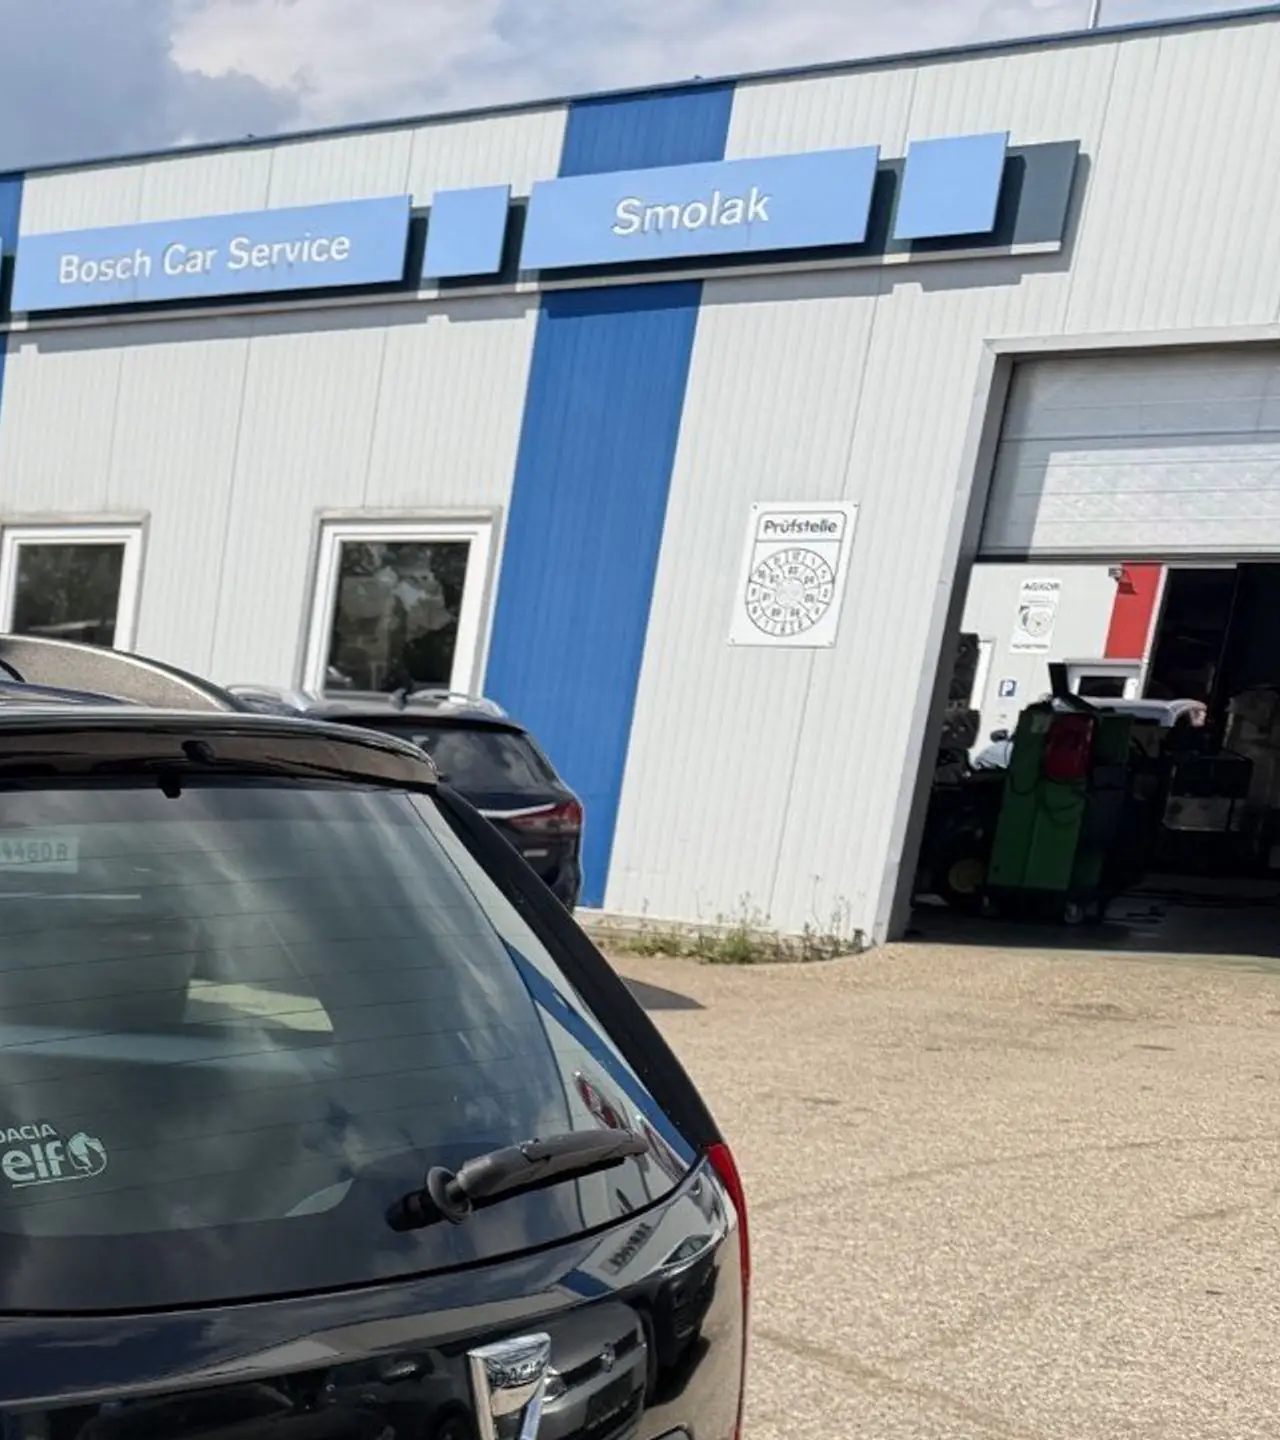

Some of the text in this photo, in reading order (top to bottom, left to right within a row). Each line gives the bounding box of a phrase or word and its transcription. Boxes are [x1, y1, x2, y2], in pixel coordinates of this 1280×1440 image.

[612, 186, 771, 236] Smolak
[59, 232, 351, 284] Bosch Car Service
[763, 518, 838, 534] Prüfstelle
[2, 1140, 65, 1181] elf
